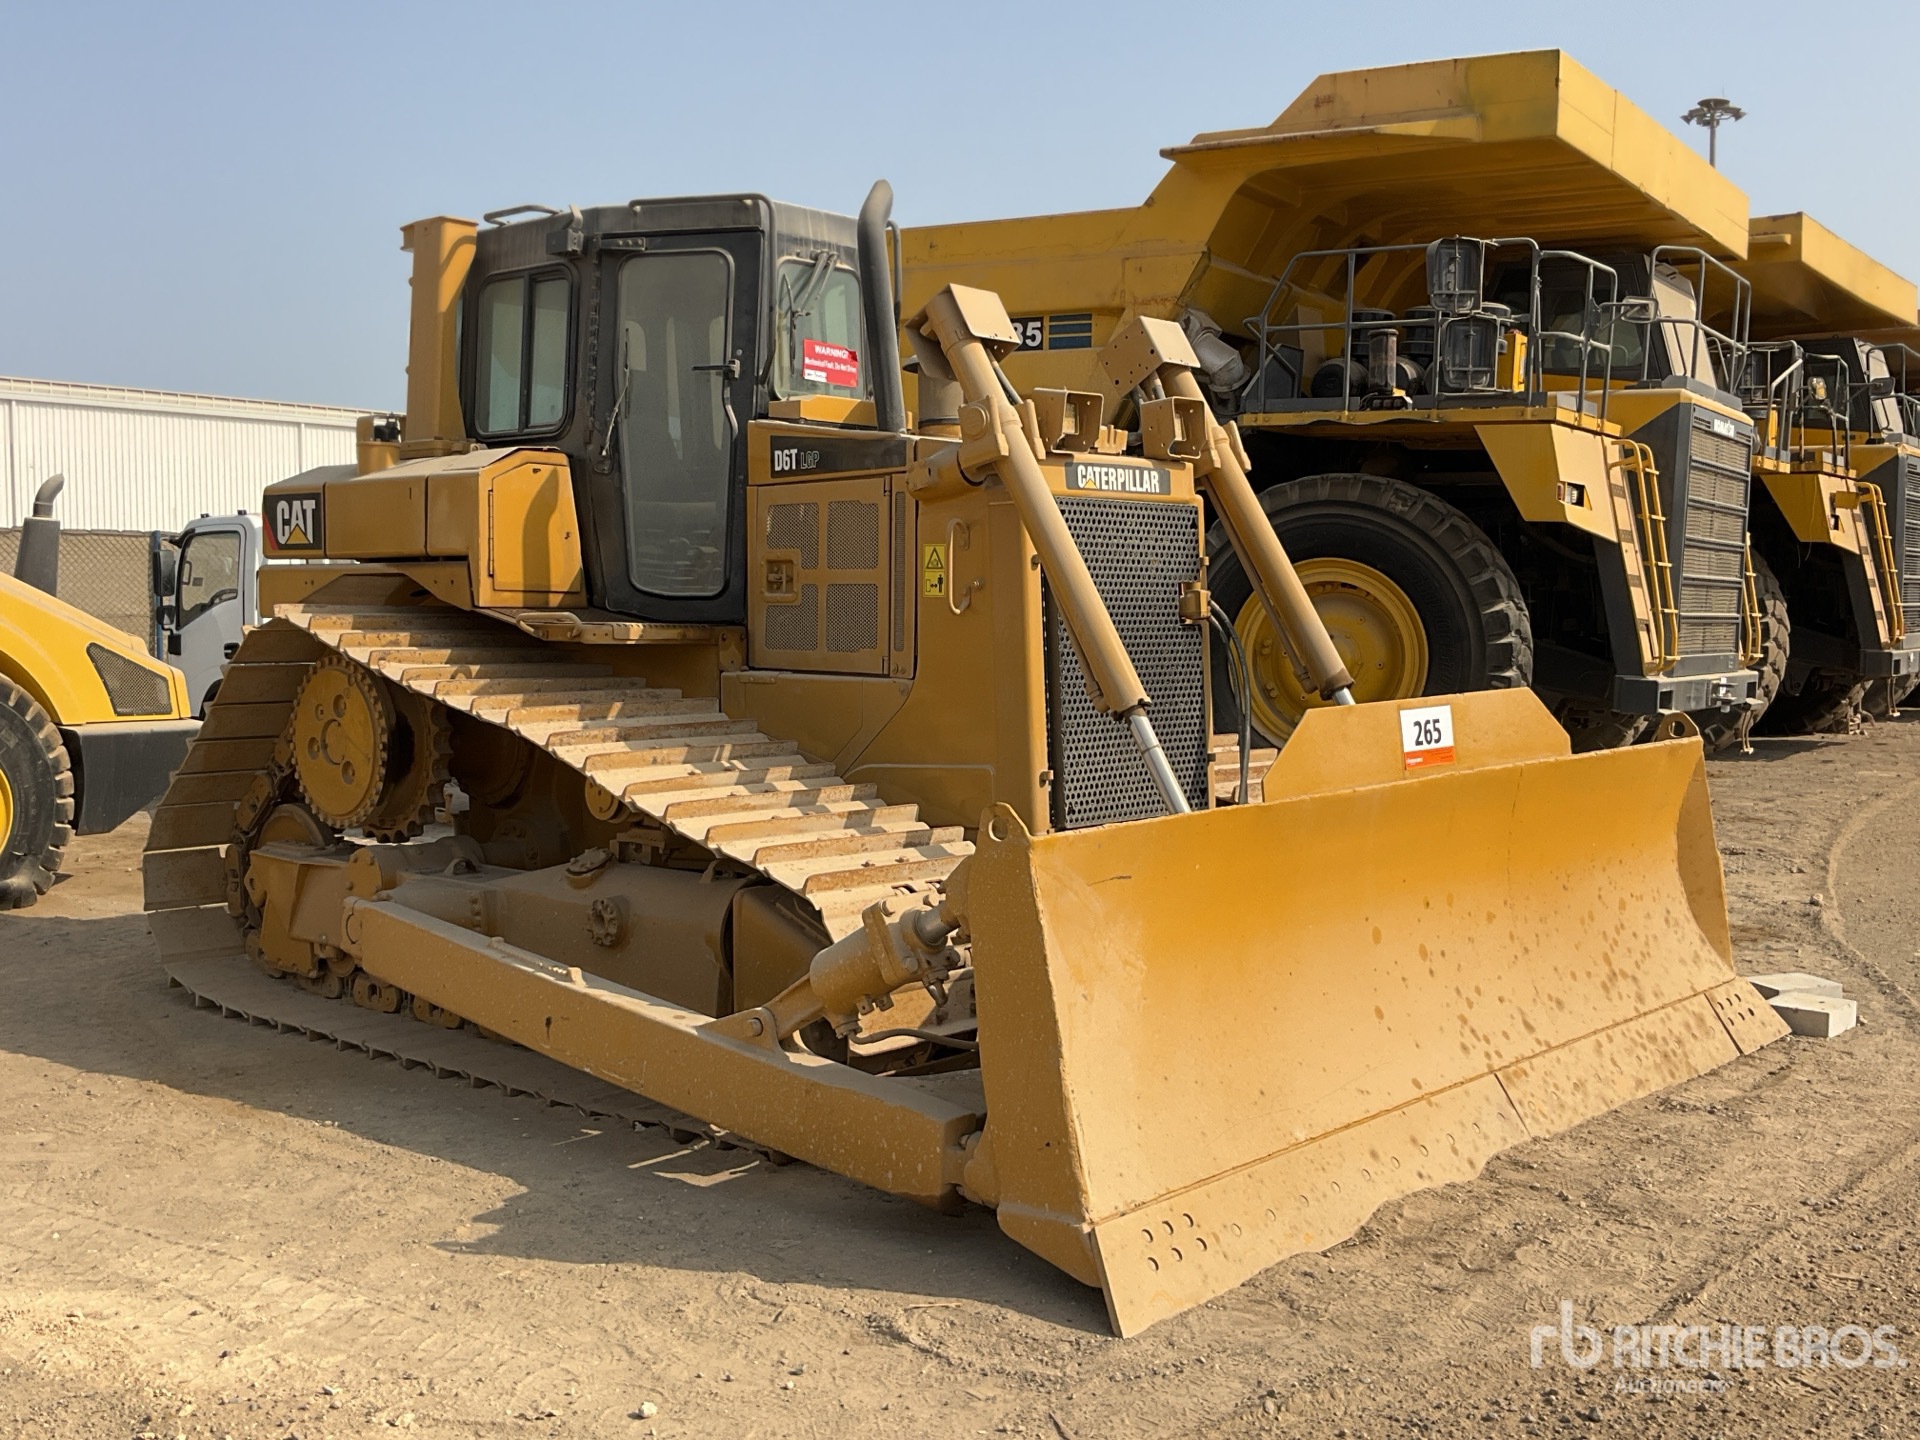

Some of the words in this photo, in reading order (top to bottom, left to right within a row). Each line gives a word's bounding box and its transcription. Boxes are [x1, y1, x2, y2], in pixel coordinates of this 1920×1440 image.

[774, 448, 798, 471] D6T
[800, 450, 820, 470] LGP
[1077, 465, 1160, 493] CATERPILLAR
[276, 499, 316, 545] CAT
[1413, 718, 1442, 747] 265
